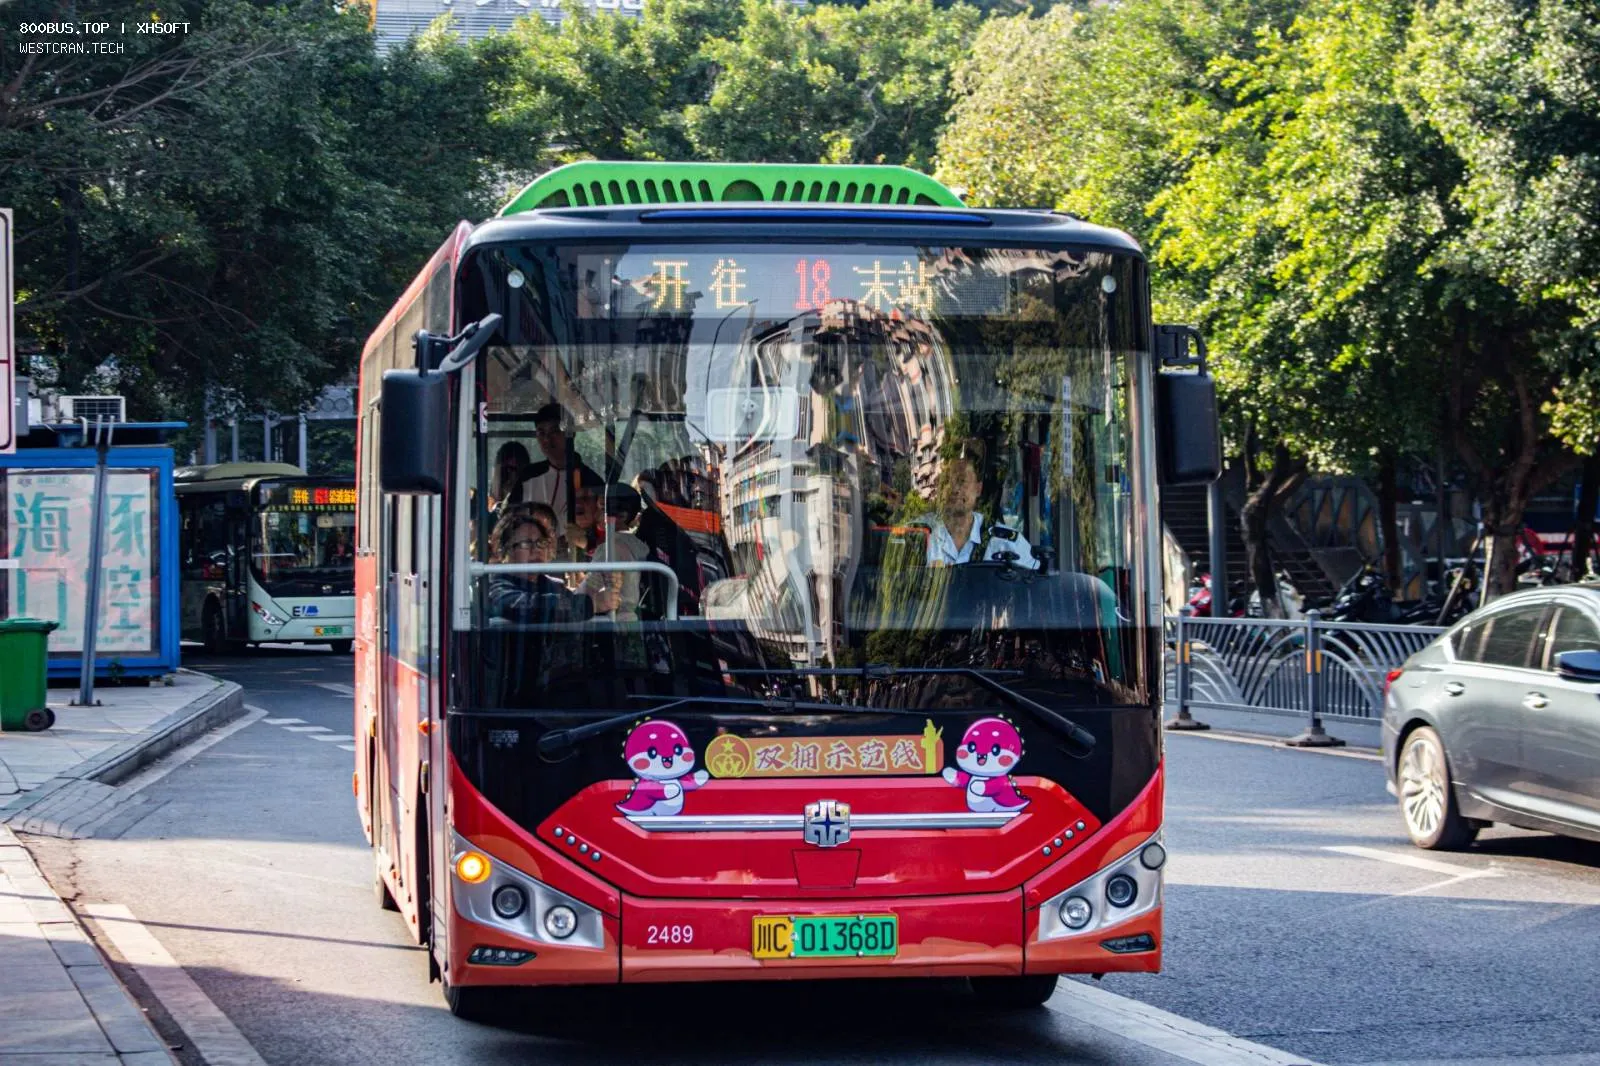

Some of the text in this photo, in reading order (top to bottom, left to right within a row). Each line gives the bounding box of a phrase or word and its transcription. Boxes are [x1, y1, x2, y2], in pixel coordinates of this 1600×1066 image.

[651, 258, 935, 311] 开往 18 末站
[754, 739, 924, 771] 双拥示范线
[647, 925, 694, 944] 2489
